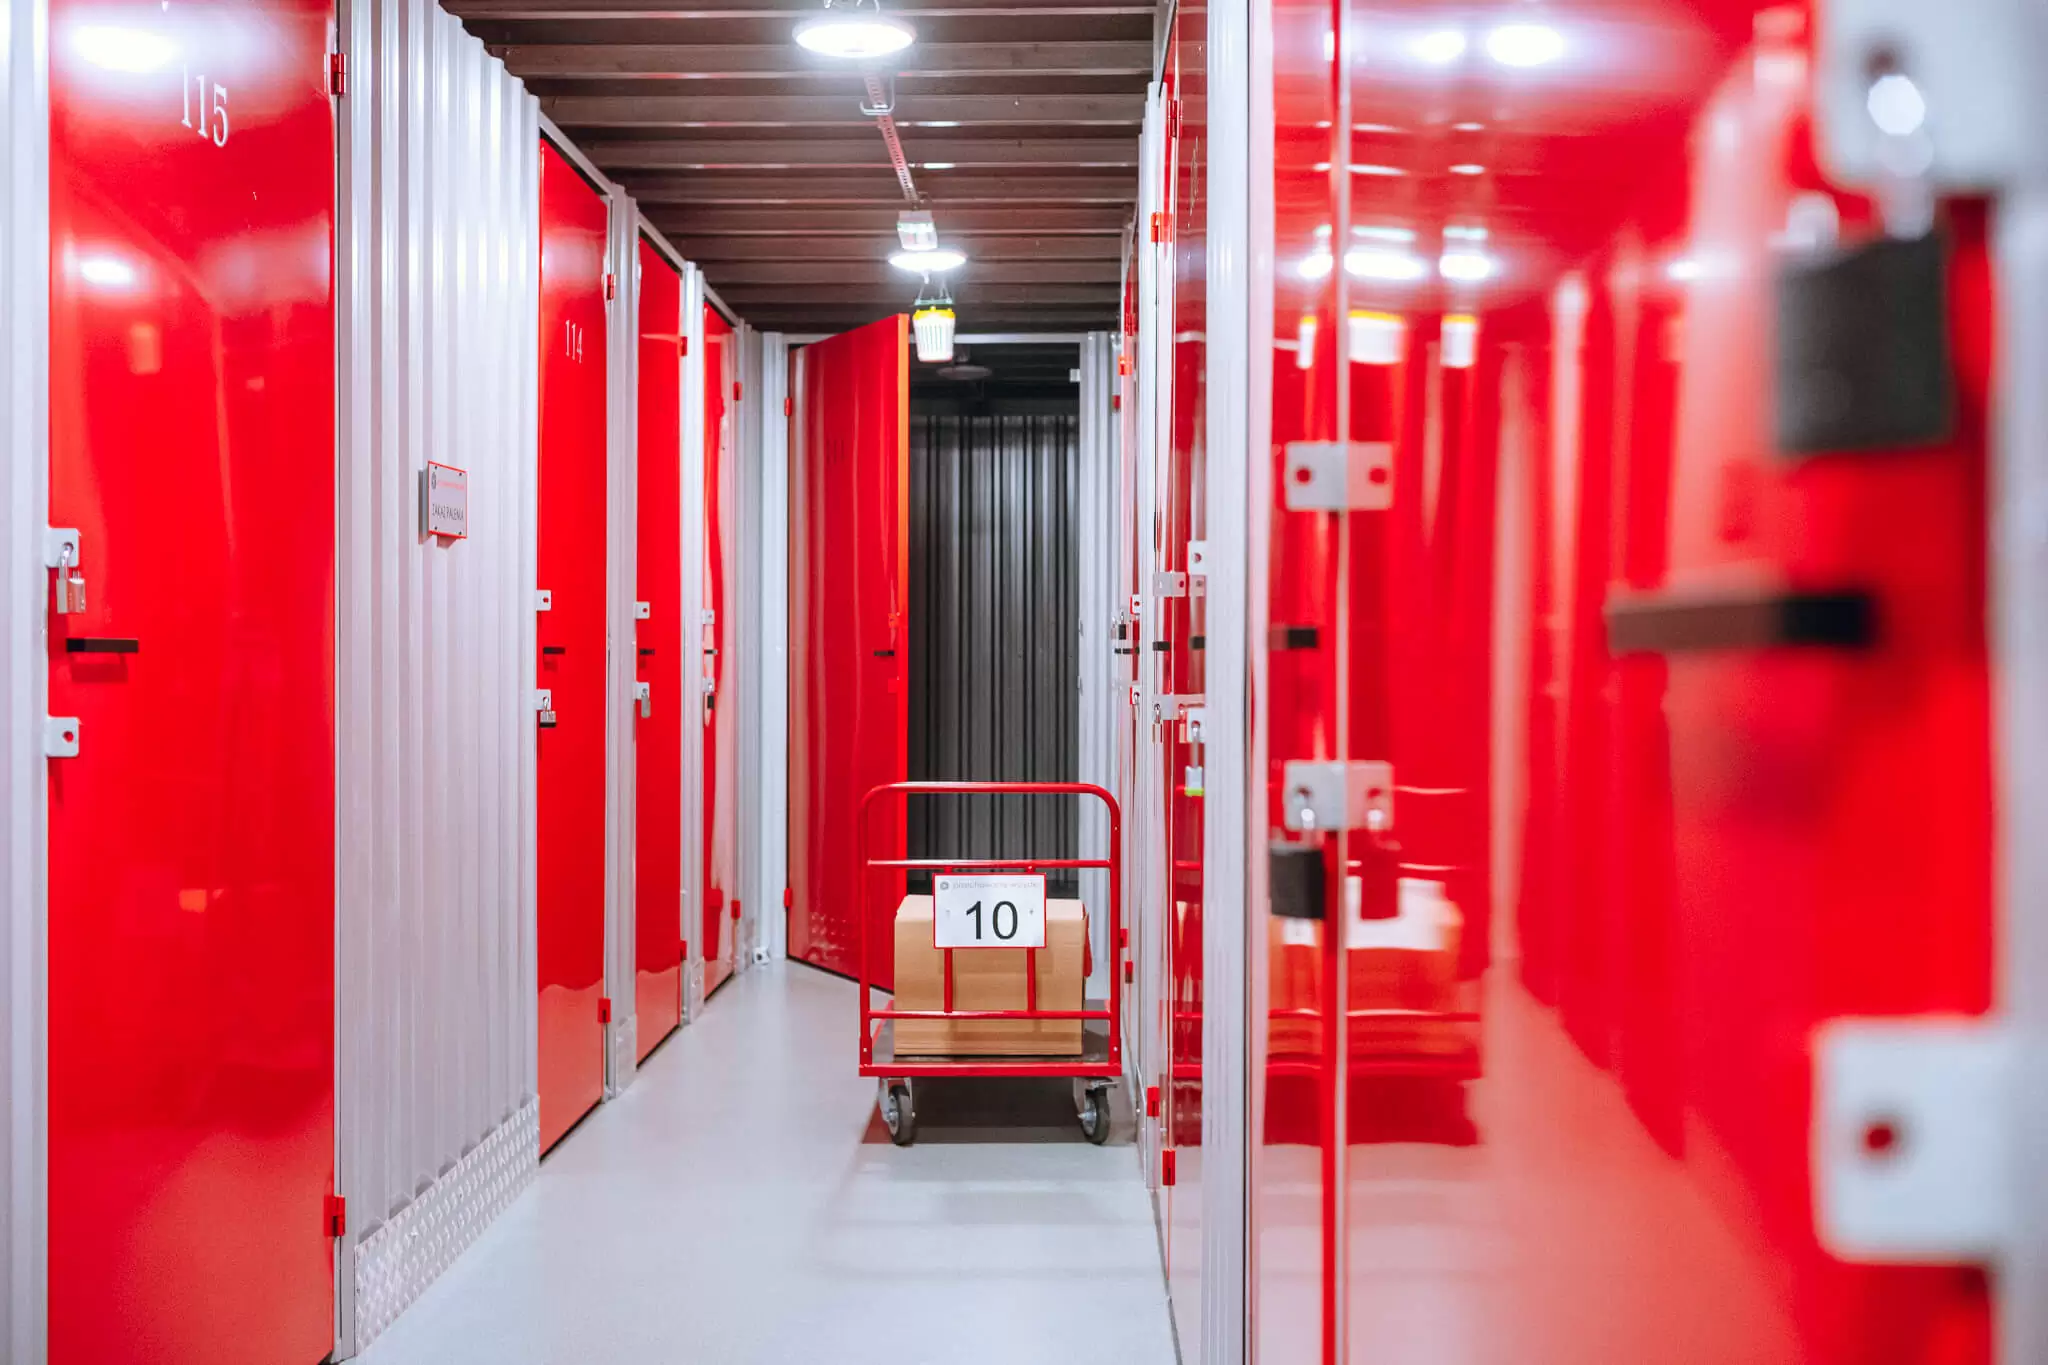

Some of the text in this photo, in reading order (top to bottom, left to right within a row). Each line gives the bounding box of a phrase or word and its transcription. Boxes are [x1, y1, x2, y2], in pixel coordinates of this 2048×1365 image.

[181, 63, 229, 148] 115
[565, 319, 583, 364] 114
[966, 900, 1018, 940] 10
